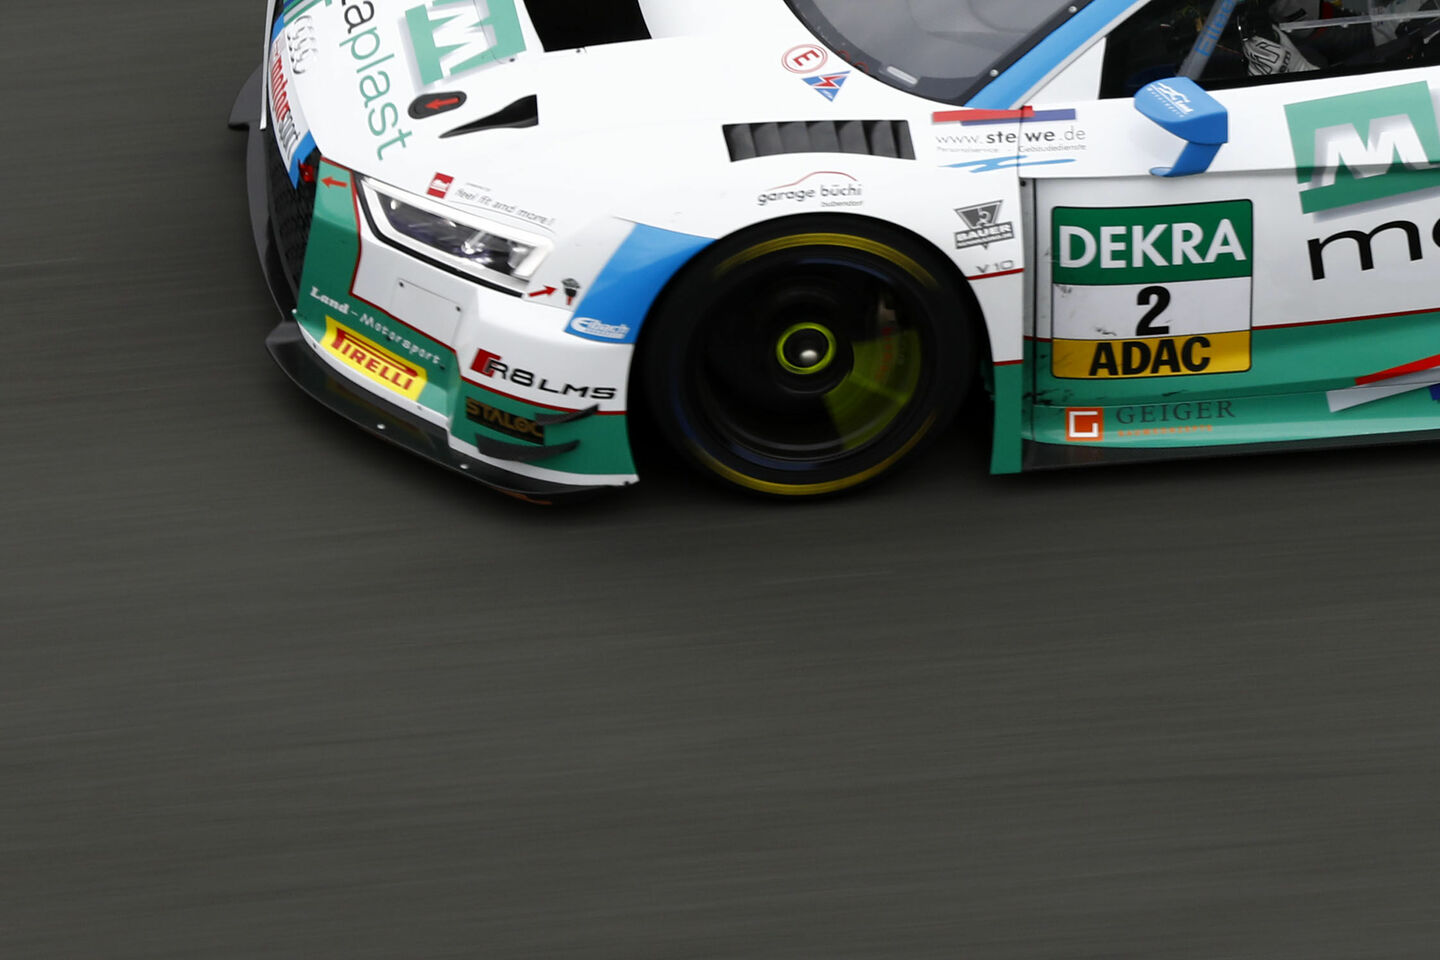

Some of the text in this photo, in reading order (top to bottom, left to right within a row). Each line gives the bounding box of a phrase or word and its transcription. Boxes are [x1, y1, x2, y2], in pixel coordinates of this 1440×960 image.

[793, 49, 821, 67] E
[757, 188, 815, 206] garage
[956, 223, 1012, 242] BAUER
[1058, 218, 1247, 269] DEKRA
[310, 286, 350, 315] Land
[360, 313, 440, 364] Motorsport
[1136, 286, 1171, 337] 2
[330, 326, 418, 390] PIRELLI
[1088, 336, 1211, 377] ADAC
[484, 358, 618, 400] R8 LMS
[1115, 400, 1236, 425] GEIGER
